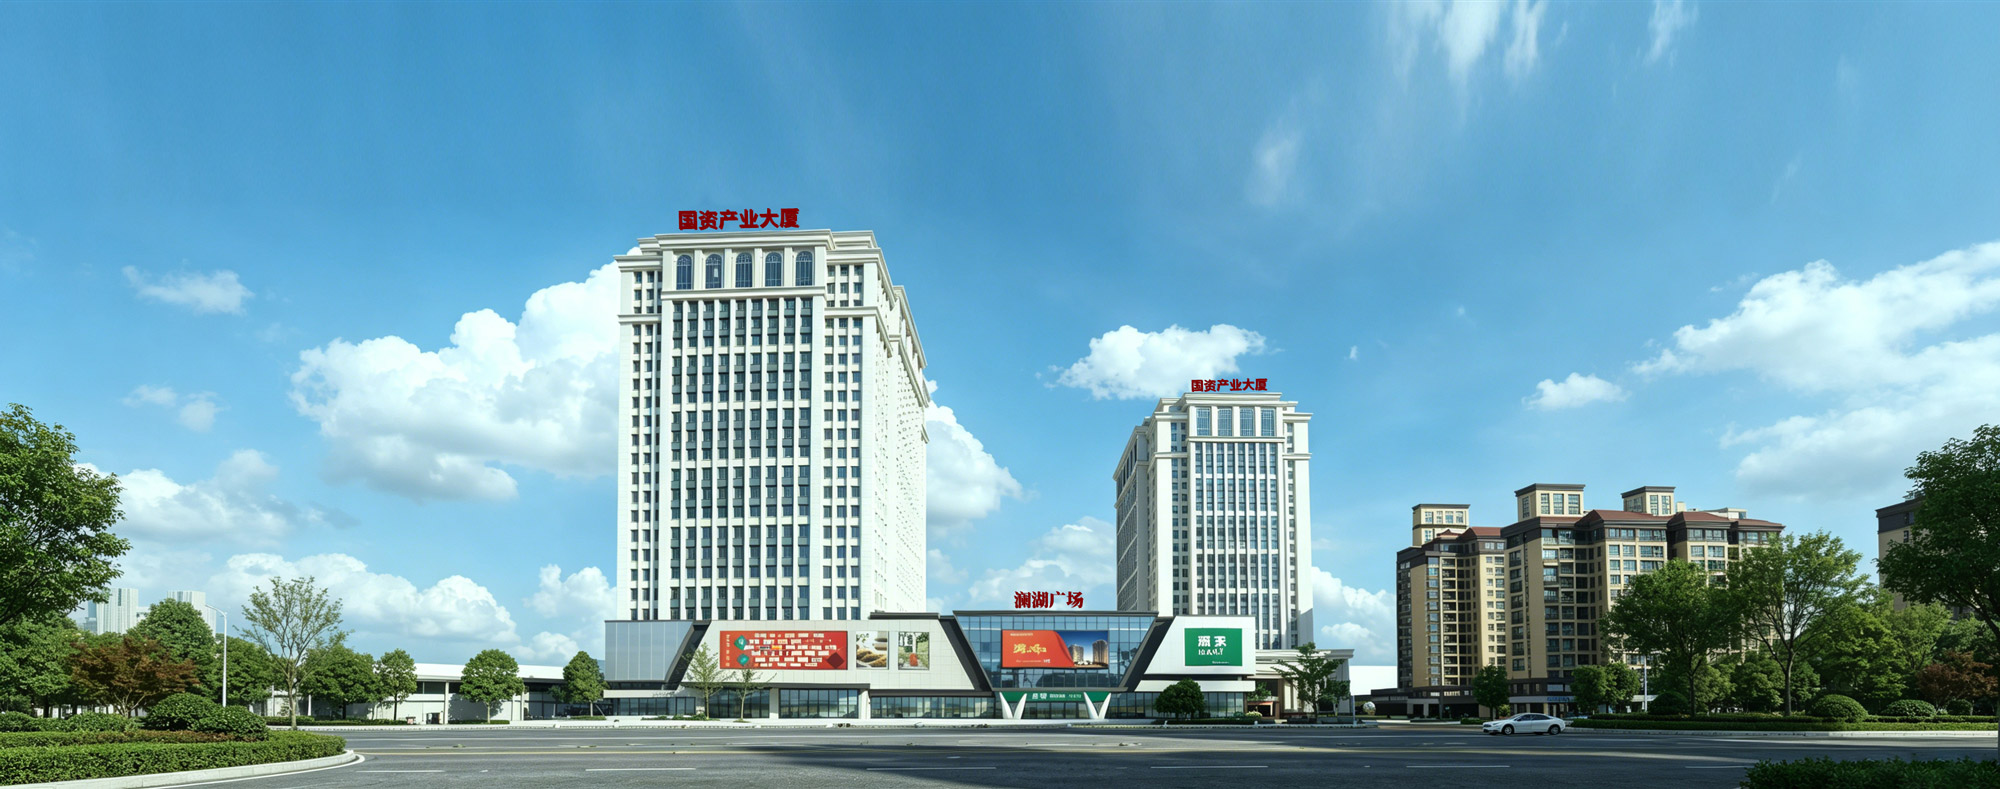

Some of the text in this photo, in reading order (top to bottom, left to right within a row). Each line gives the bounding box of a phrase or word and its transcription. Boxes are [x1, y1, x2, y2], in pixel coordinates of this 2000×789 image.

[678, 208, 800, 231] 国资产业大厦
[1191, 378, 1268, 392] 国资产业大厦
[1013, 591, 1084, 609] 澜湖广场
